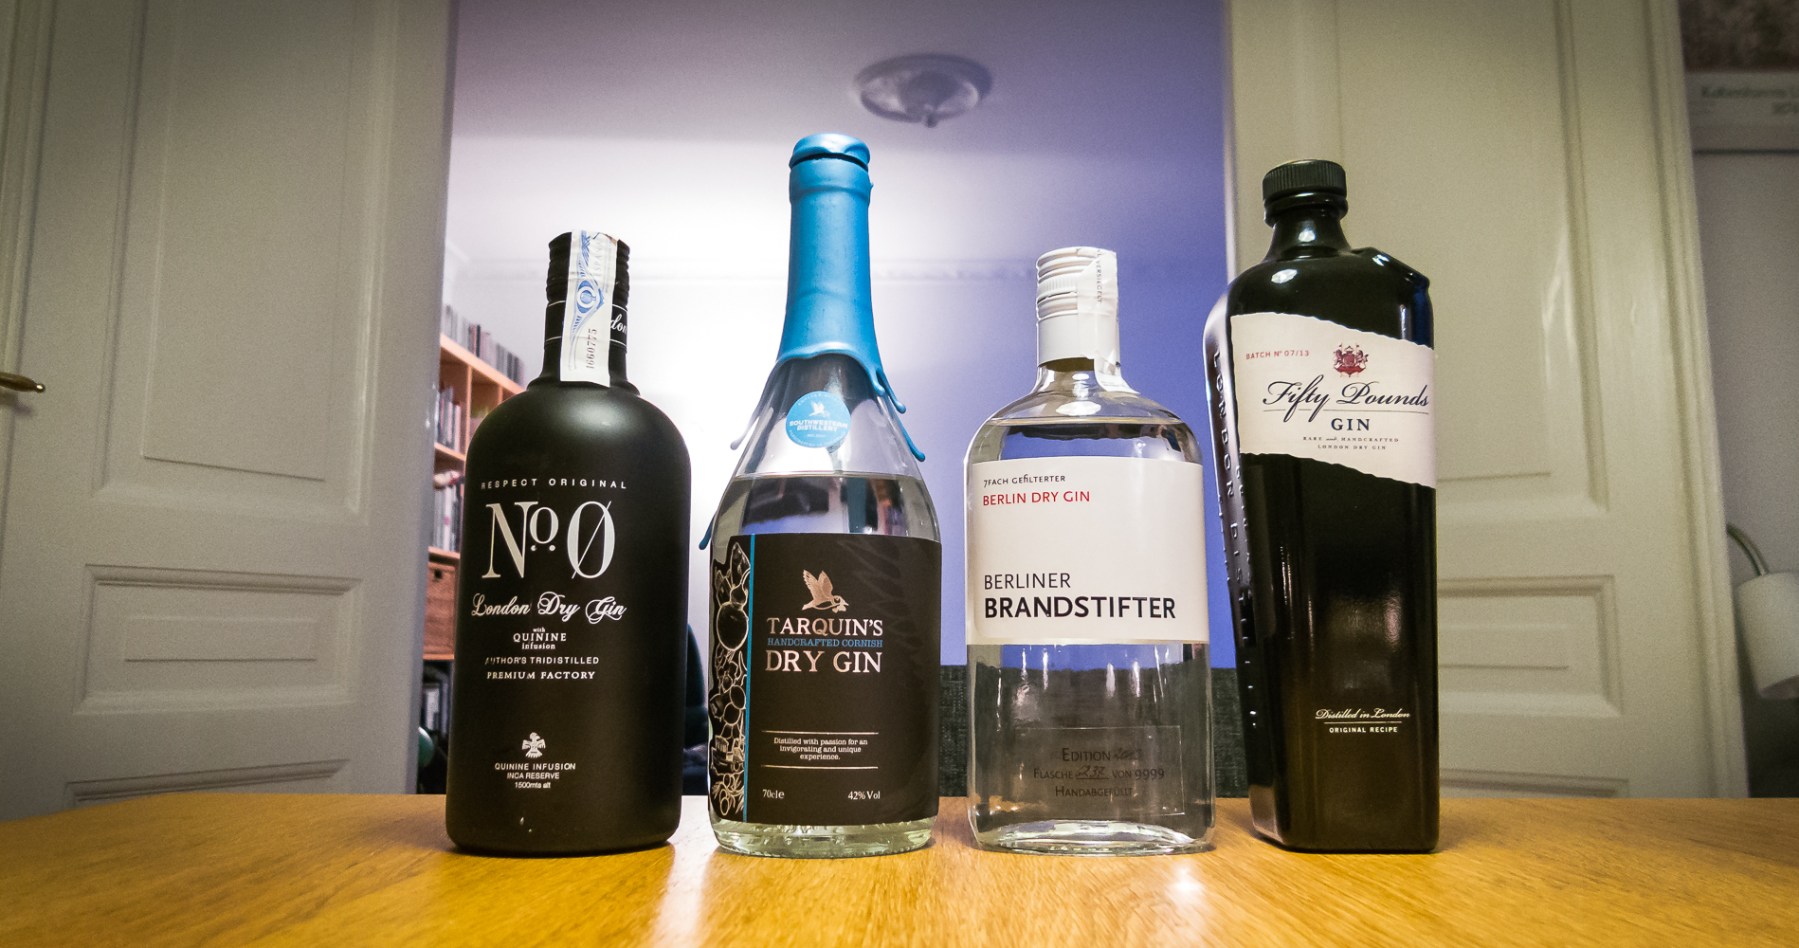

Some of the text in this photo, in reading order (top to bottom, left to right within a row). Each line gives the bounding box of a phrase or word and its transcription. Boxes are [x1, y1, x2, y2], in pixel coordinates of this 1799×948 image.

[1246, 351, 1271, 360] BATCH
[1262, 374, 1430, 423] Fifty Pounds
[1330, 418, 1370, 431] GIN
[481, 478, 626, 490] RESPECT ORIGINAL
[983, 476, 1009, 488] 7FACH
[982, 491, 1090, 506] BERLIN DRY GIN
[984, 572, 1071, 590] BERLINER
[471, 591, 627, 625] London Dry Gin
[985, 596, 1176, 619] BRANDSTIFTER
[766, 617, 884, 637] TARQUIN'S
[513, 632, 567, 642] QUININE
[522, 642, 556, 650] infusion
[767, 638, 883, 648] HANDCRAFTED CORNISH
[530, 656, 600, 664] TRIDISTILLED
[765, 650, 883, 673] DRY GIN
[486, 671, 596, 680] PREMIUM FACTORY
[1315, 708, 1410, 720] Distilled in London
[1328, 726, 1366, 734] ORIGINAL
[820, 738, 847, 746] passion
[780, 746, 822, 754] invigorating
[838, 746, 862, 754] unique
[494, 762, 576, 771] QUININE INFUSION
[506, 772, 560, 780] INCA RESERVE
[1134, 768, 1165, 780] 9999
[848, 791, 881, 800] 42% Vol
